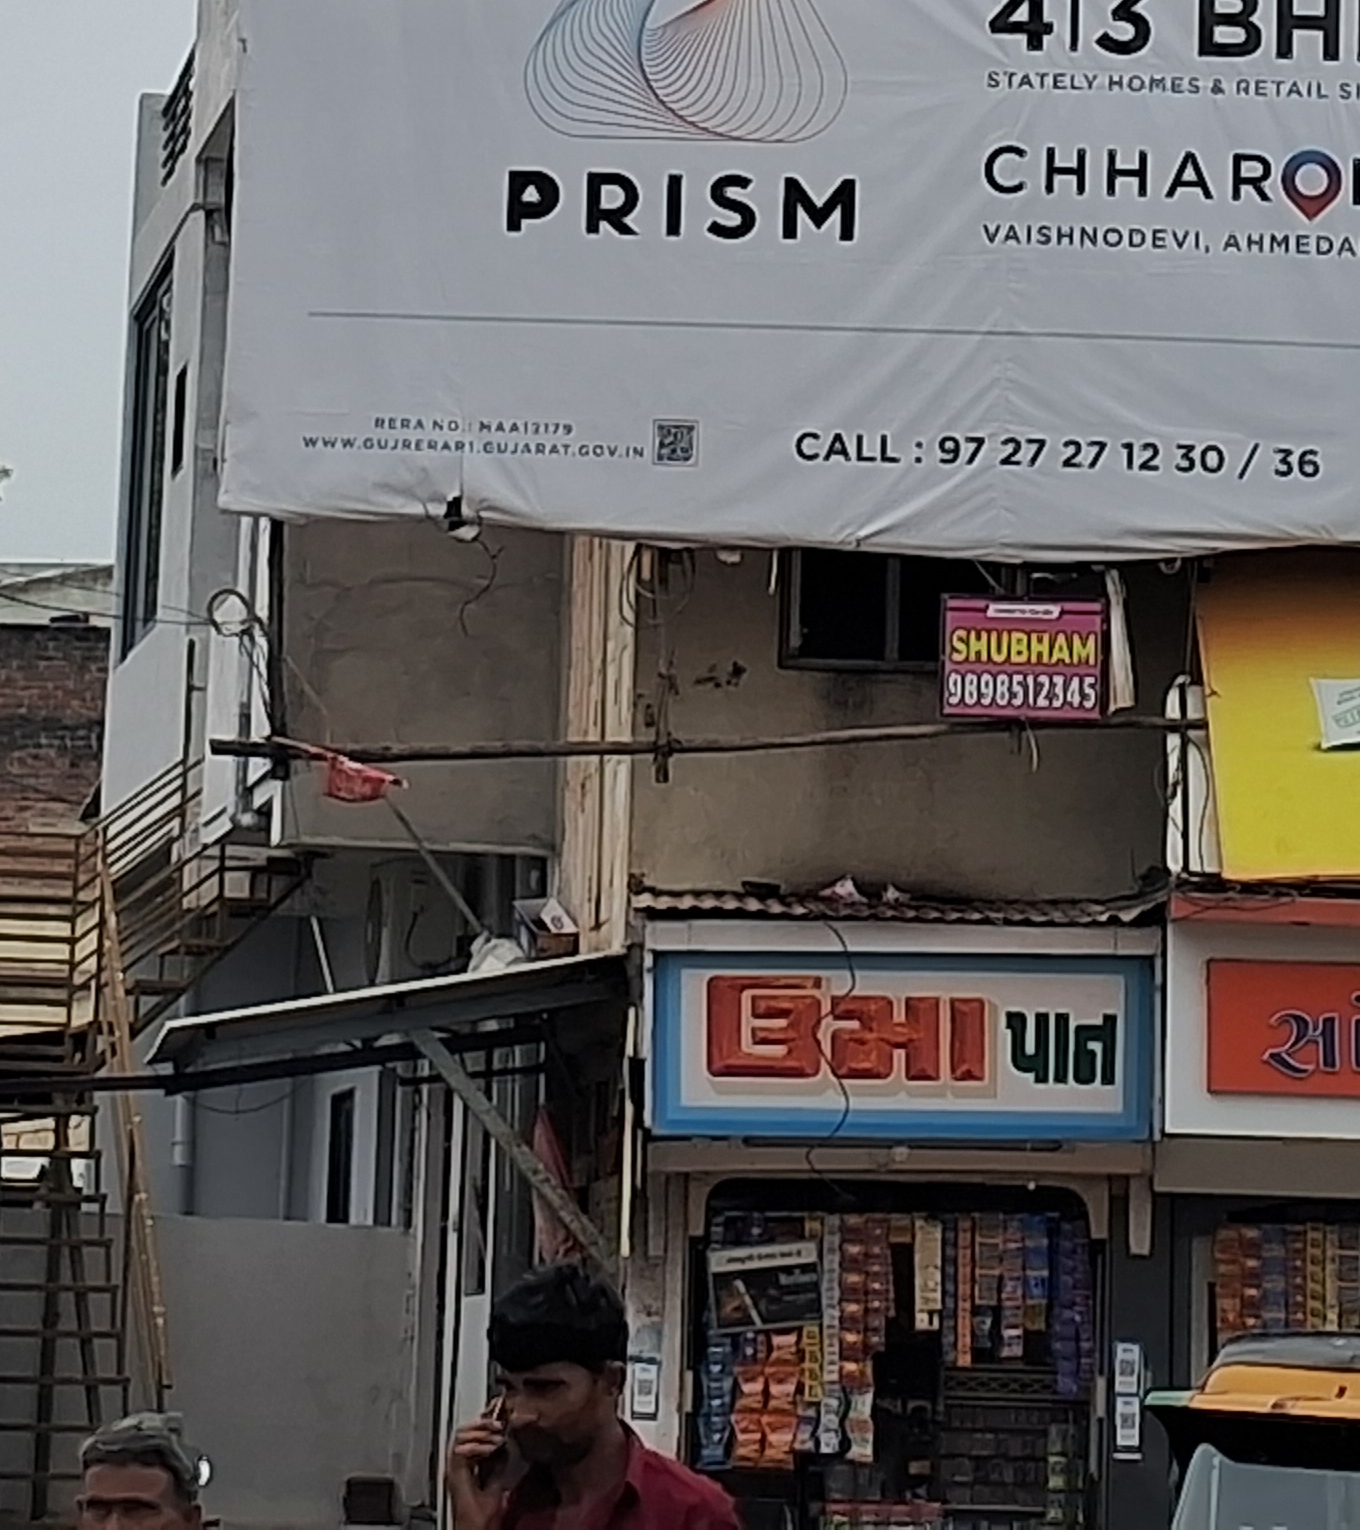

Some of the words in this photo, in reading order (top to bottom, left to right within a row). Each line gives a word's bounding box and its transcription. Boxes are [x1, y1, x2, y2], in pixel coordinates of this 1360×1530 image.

[986, 71, 1099, 92] STATELY
[1108, 74, 1200, 95] HOMES
[1210, 78, 1226, 96] &
[1236, 78, 1329, 100] RETAIL
[505, 169, 858, 242] PRISM
[983, 224, 1210, 254] VAISHNODEVI,
[374, 416, 425, 431] RERA
[795, 431, 901, 464] CALL
[937, 436, 986, 466] 97
[998, 437, 1046, 468] 27
[1061, 439, 1108, 470] 27
[1121, 441, 1160, 472] 12
[1174, 443, 1225, 474] 30
[1274, 447, 1321, 478] 36
[951, 628, 1096, 666] SHUBHAM
[948, 672, 1096, 708] 9898512345
[706, 975, 986, 1082] ઉમા
[1005, 1010, 1118, 1086] પાન
